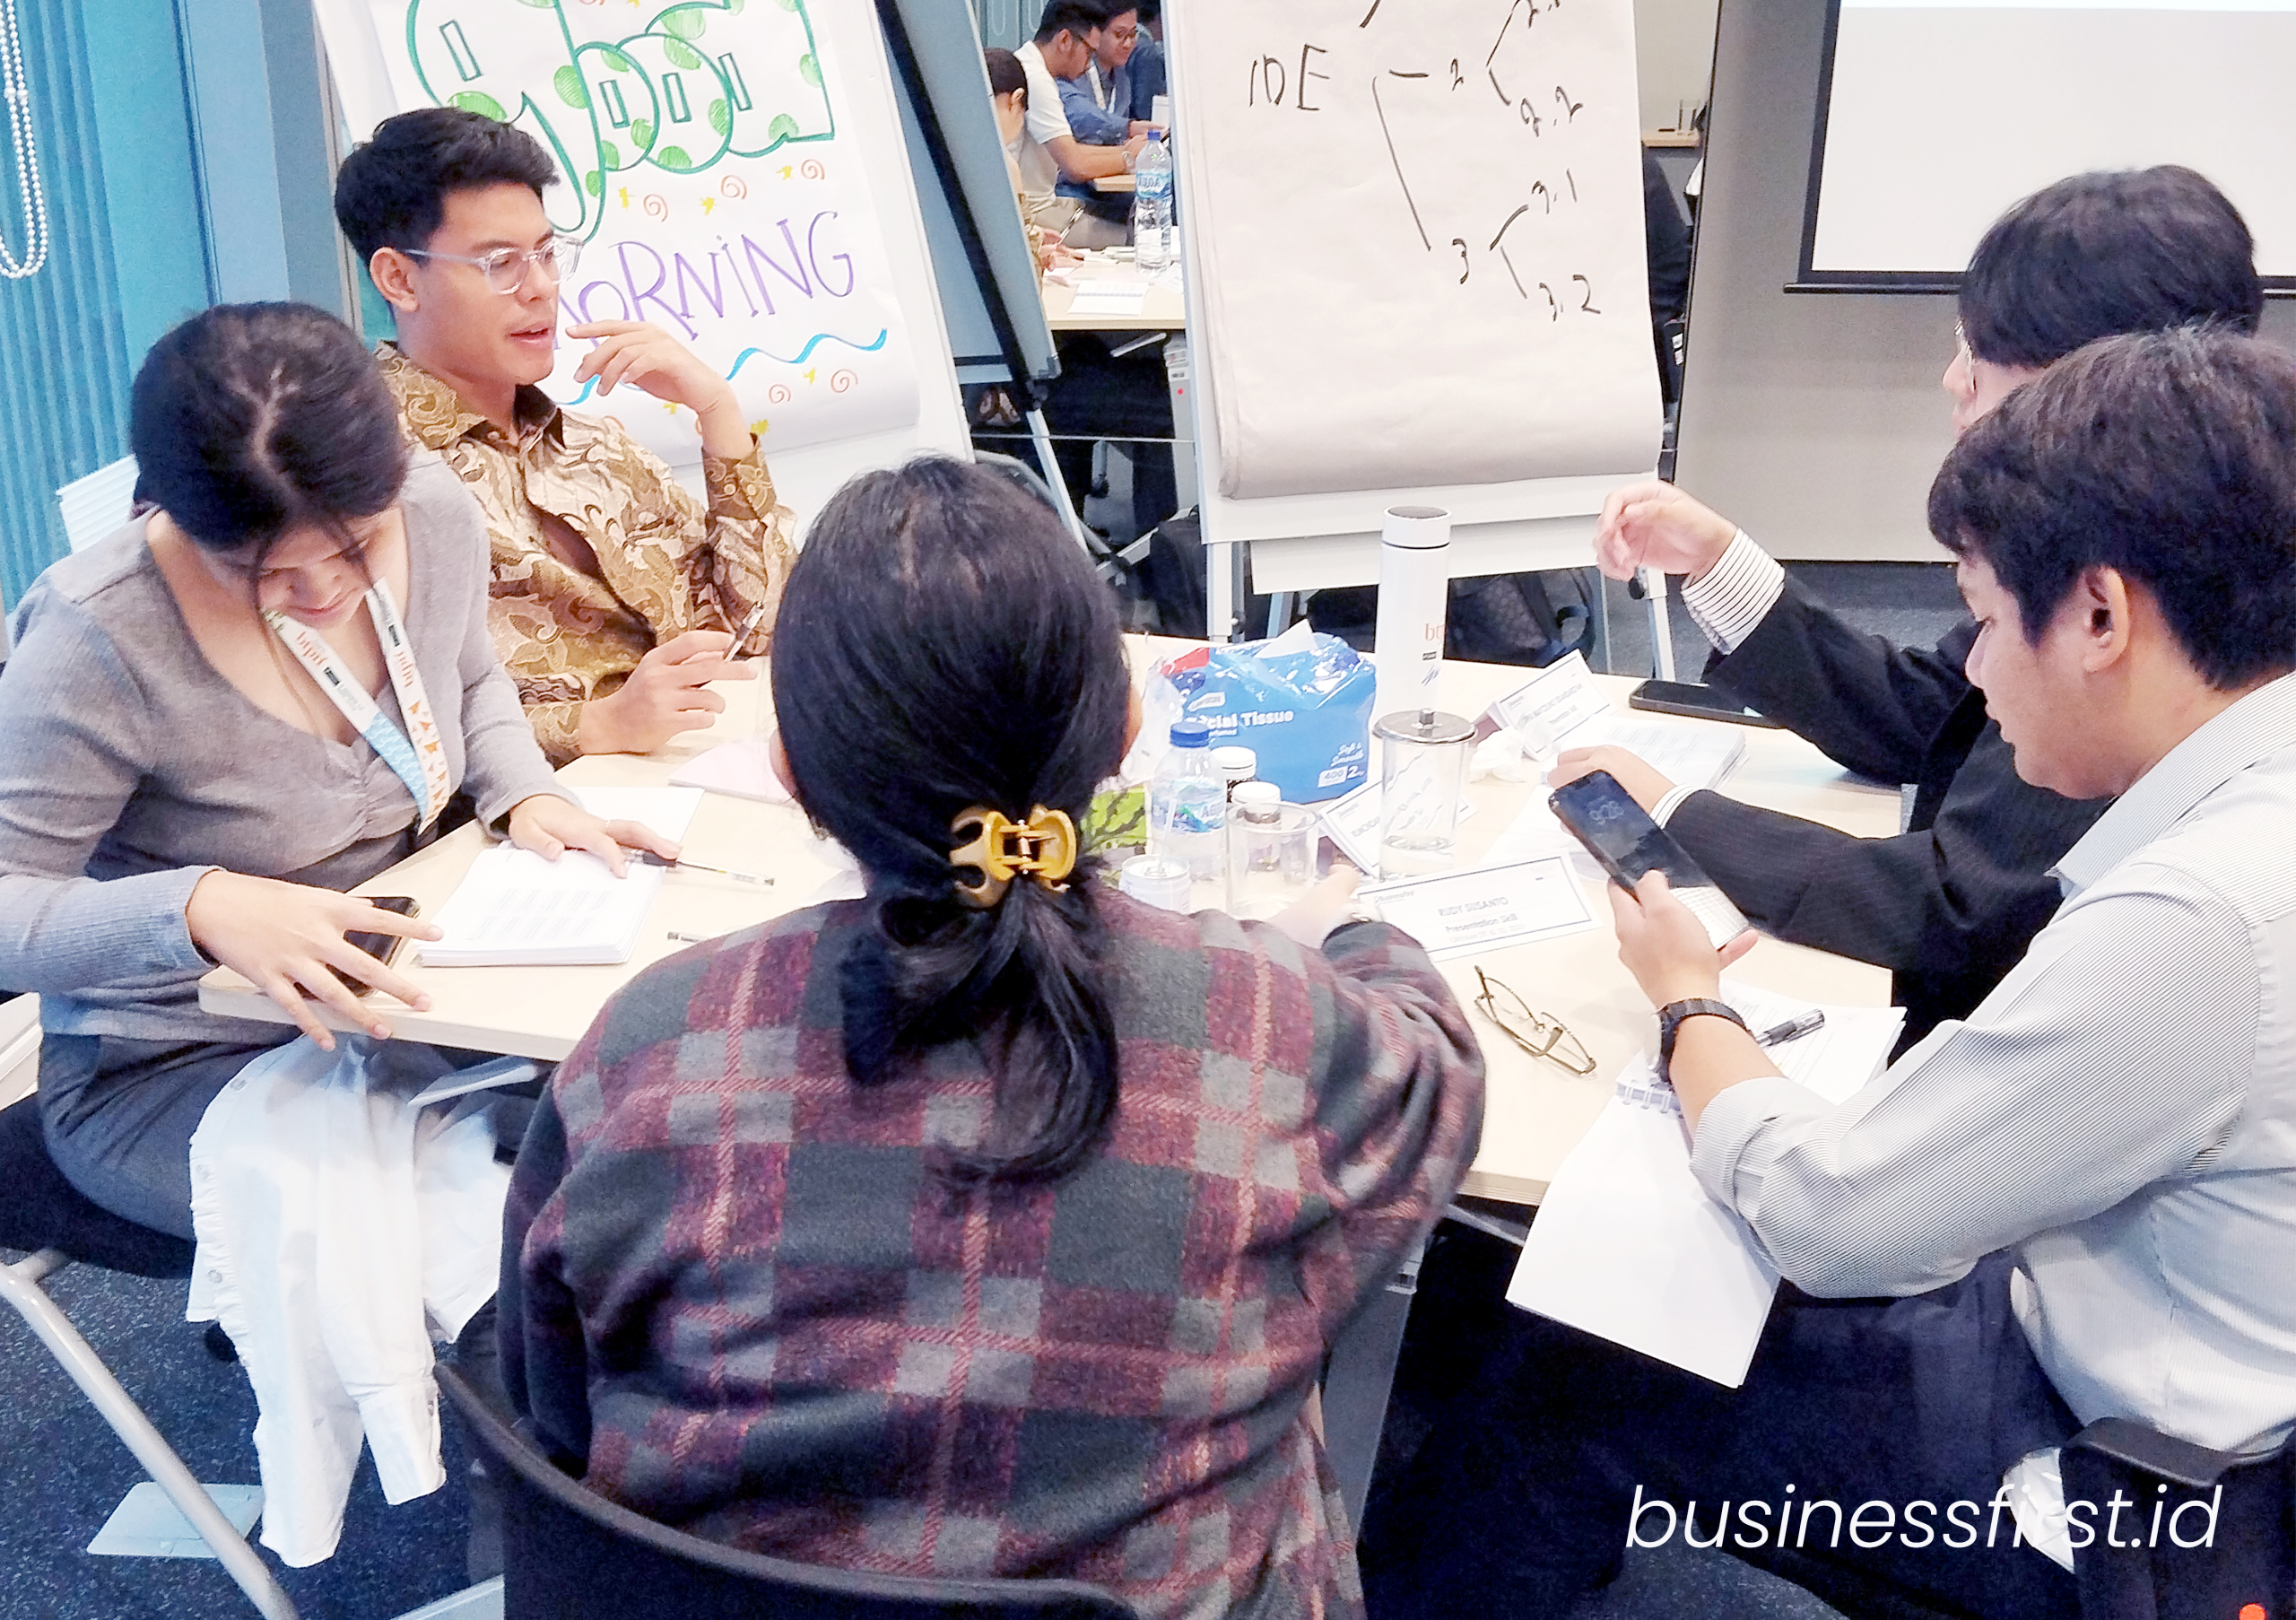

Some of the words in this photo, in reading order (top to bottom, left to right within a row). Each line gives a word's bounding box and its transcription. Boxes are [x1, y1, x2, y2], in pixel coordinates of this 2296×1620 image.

[1451, 238, 1469, 285] 3
[1185, 713, 1239, 729] cial
[1240, 710, 1294, 727] Tissue
